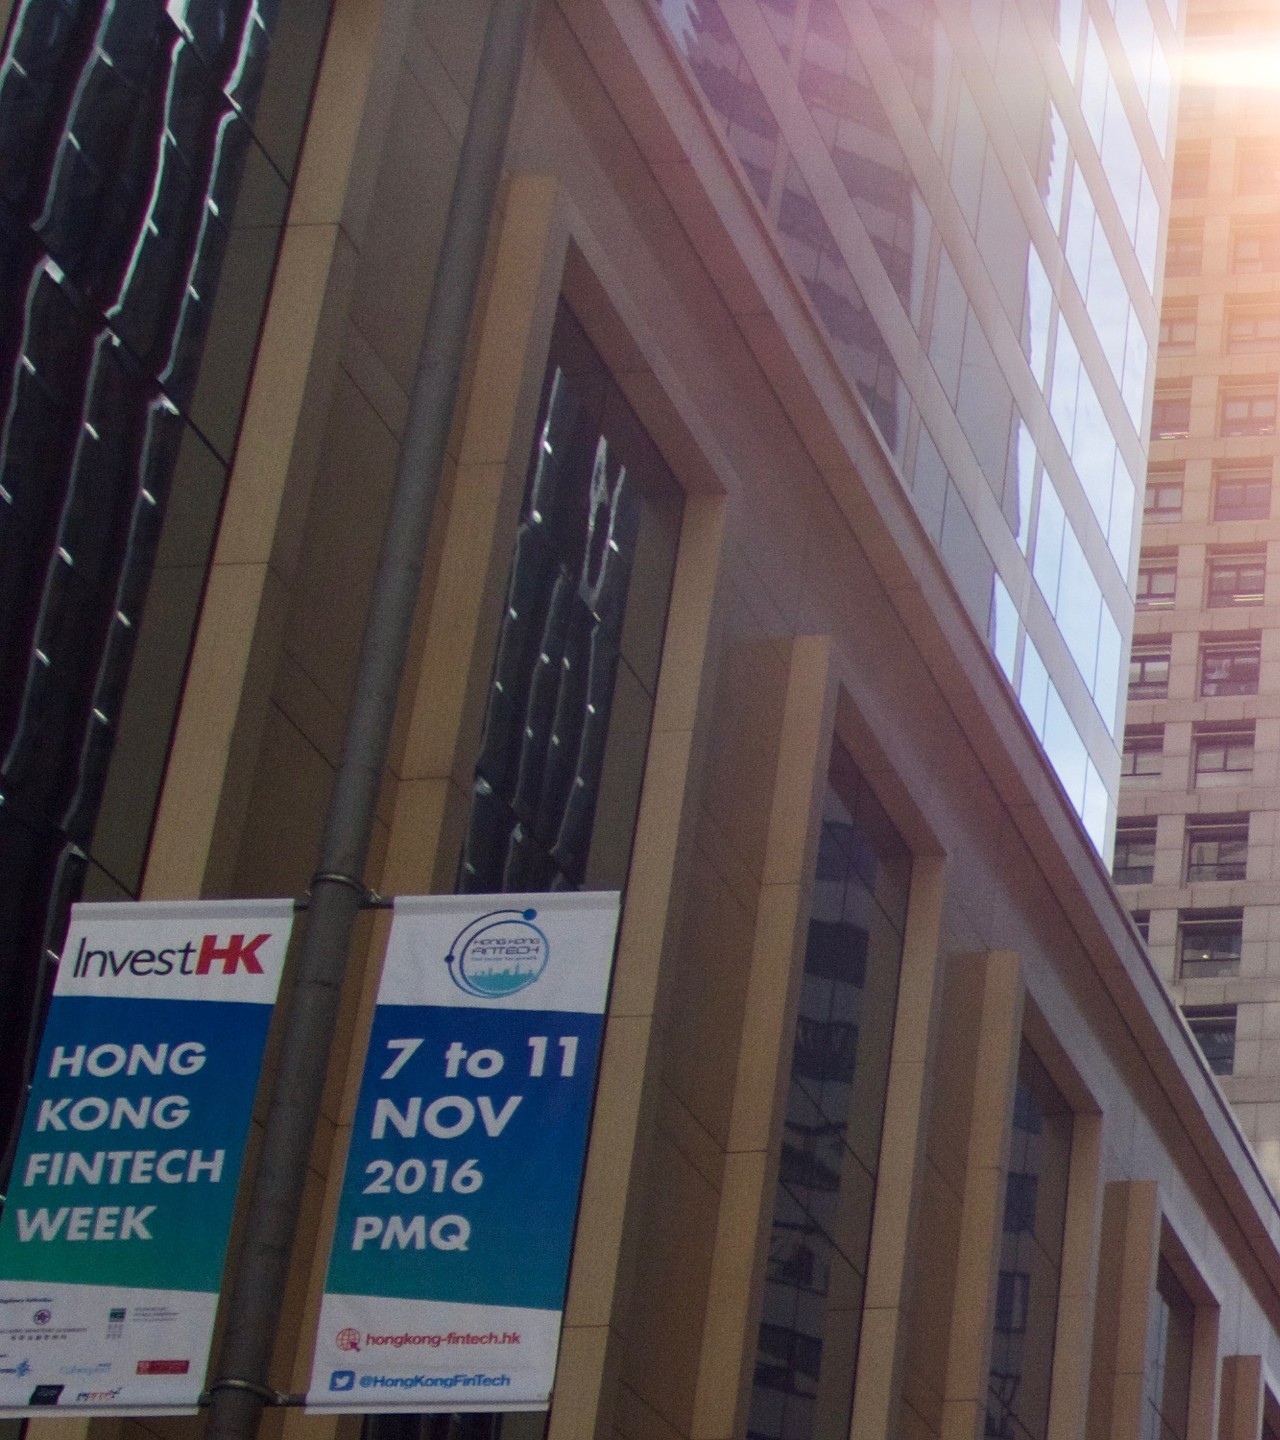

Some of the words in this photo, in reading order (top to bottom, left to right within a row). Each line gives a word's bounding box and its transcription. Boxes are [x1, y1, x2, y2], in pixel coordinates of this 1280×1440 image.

[73, 933, 272, 980] InvestHK
[48, 1041, 207, 1079] HONG
[381, 1038, 425, 1079] 7
[444, 1041, 504, 1078] to
[527, 1037, 578, 1077] 11
[36, 1095, 190, 1132] KONG
[371, 1095, 521, 1140] NOV
[23, 1149, 225, 1187] FINTECH
[362, 1159, 484, 1195] 2016
[16, 1205, 157, 1242] WEEK
[351, 1214, 471, 1252] PMQ
[366, 1332, 520, 1348] hongkong-fintech.hk
[359, 1374, 510, 1390] @HongKongFinTech
